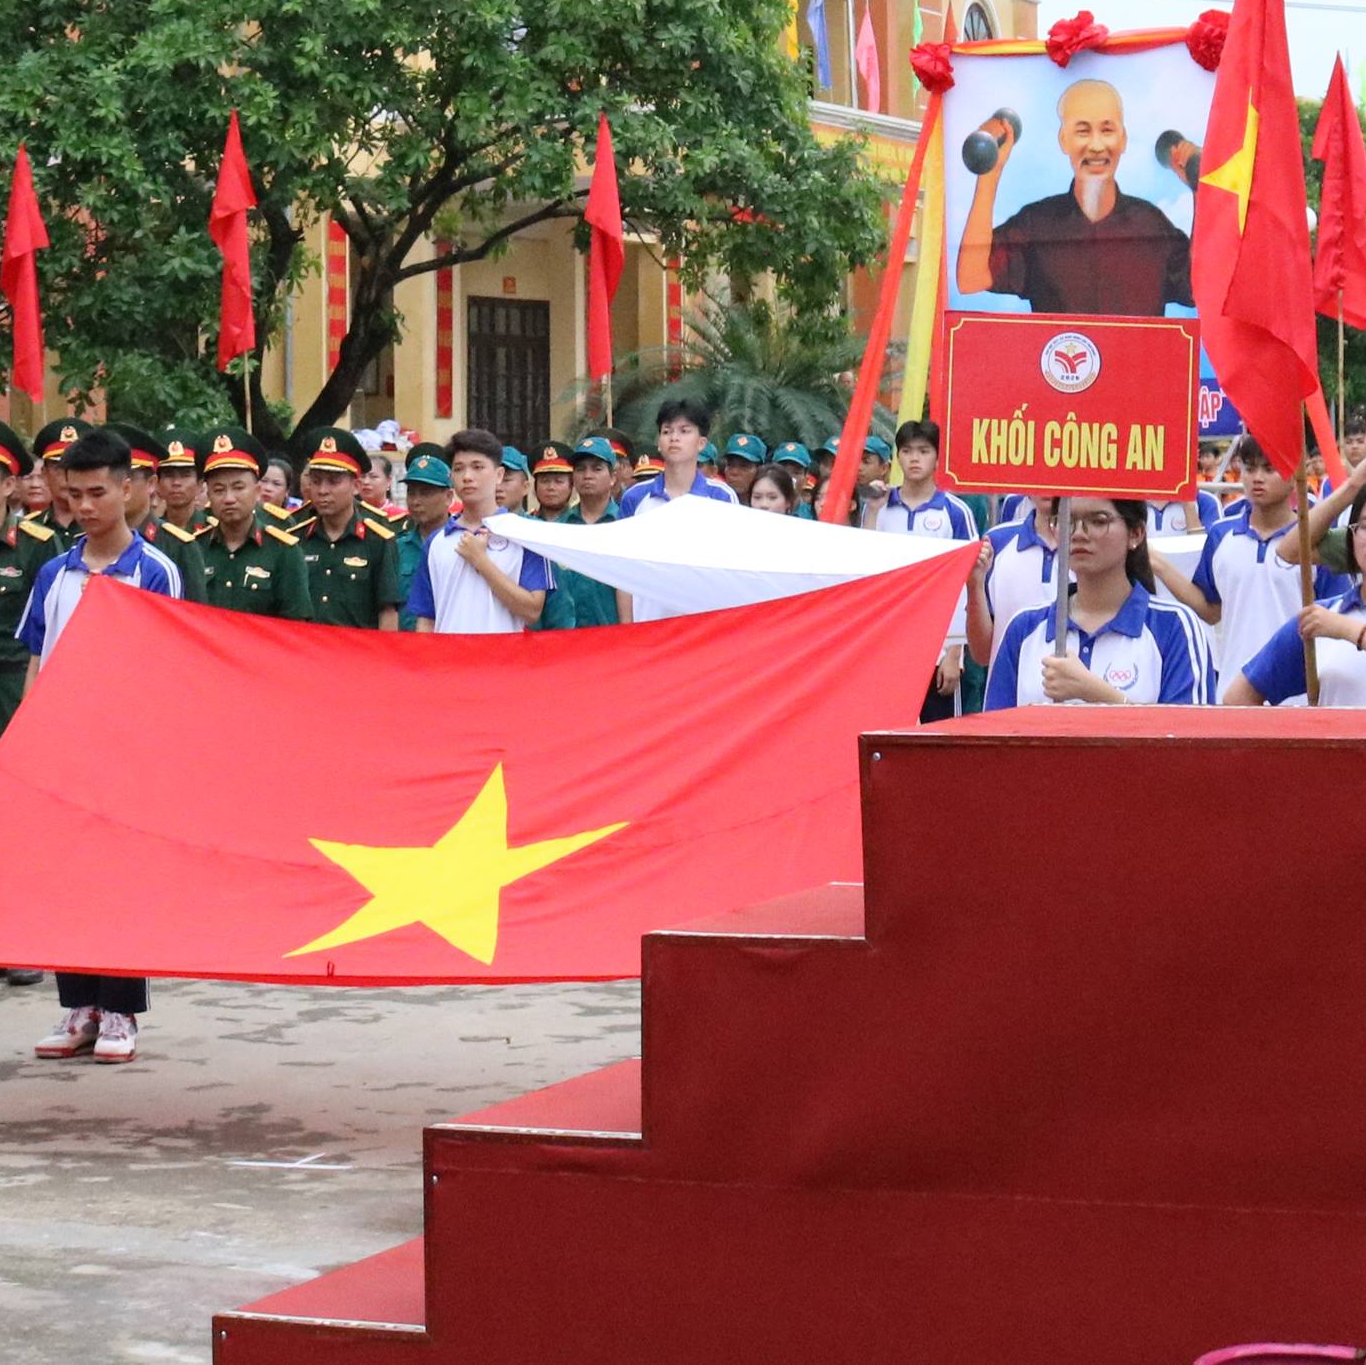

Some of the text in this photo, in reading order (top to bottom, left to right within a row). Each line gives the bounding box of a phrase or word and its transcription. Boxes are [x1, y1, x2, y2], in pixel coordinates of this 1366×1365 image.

[971, 402, 1165, 471] KHỐI CÔNG AN
